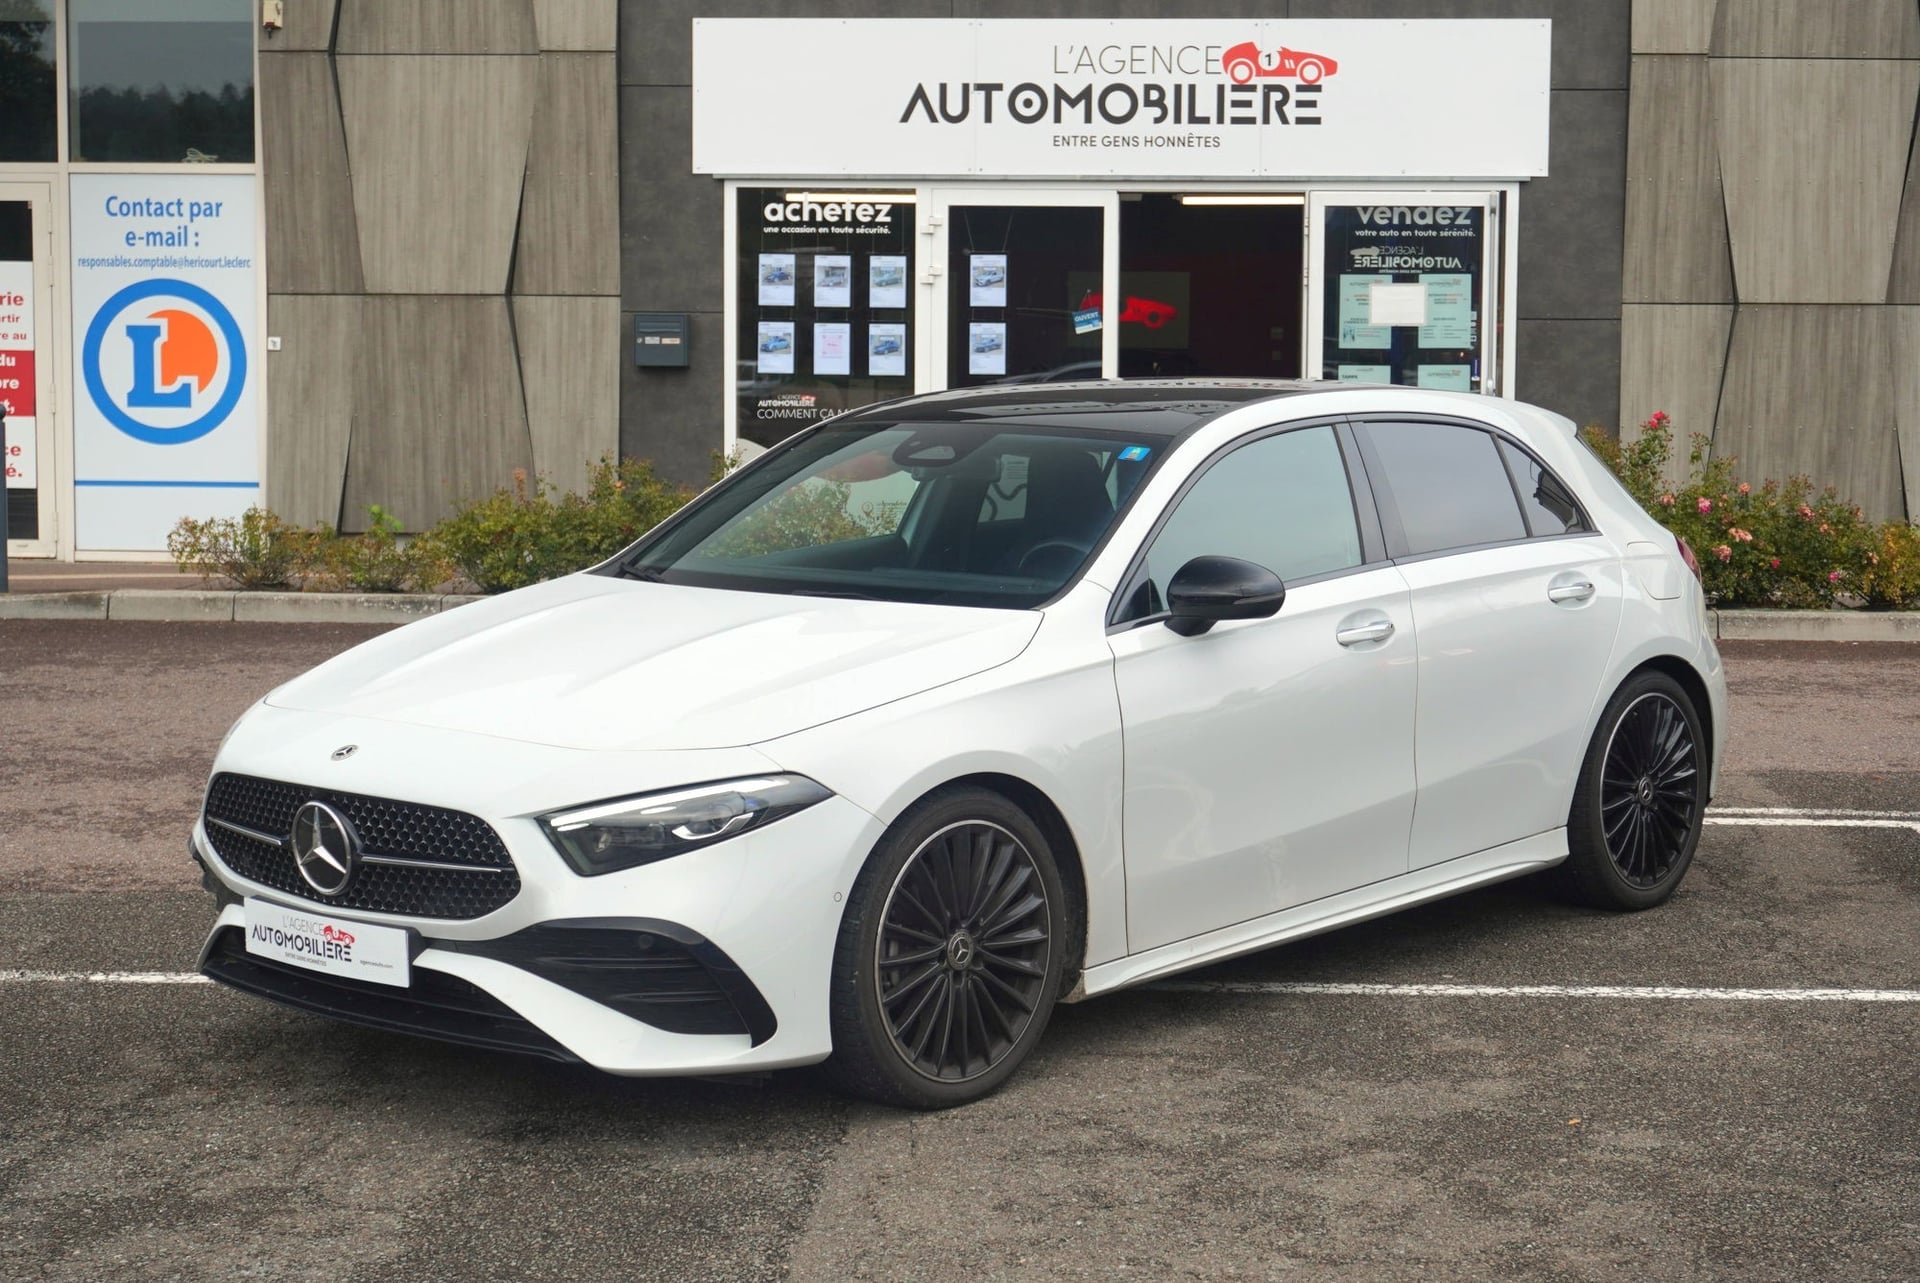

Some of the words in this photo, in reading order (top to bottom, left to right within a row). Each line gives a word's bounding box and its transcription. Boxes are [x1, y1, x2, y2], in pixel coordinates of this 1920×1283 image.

[1052, 45, 1222, 75] L'AGENCE
[1053, 135, 1097, 147] ENTRE
[1101, 135, 1140, 148] GENS
[1144, 132, 1221, 148] HONNÊTES
[105, 195, 184, 217] Contact
[188, 201, 223, 222] par
[763, 192, 892, 223] achetez
[1356, 207, 1471, 225] vendez
[124, 225, 188, 247] e-mail
[763, 226, 779, 234] une
[781, 224, 816, 234] occasion
[818, 226, 829, 234] en
[831, 225, 854, 234] toute
[855, 224, 891, 234] sécurité.
[1354, 229, 1377, 237] votre
[1379, 229, 1399, 237] auto
[1401, 229, 1412, 237] en
[1414, 229, 1437, 237] toute
[1439, 227, 1476, 237] sérénité.
[13, 332, 27, 341] au
[757, 408, 818, 419] COMMENT
[282, 916, 324, 936] L'AGENCE
